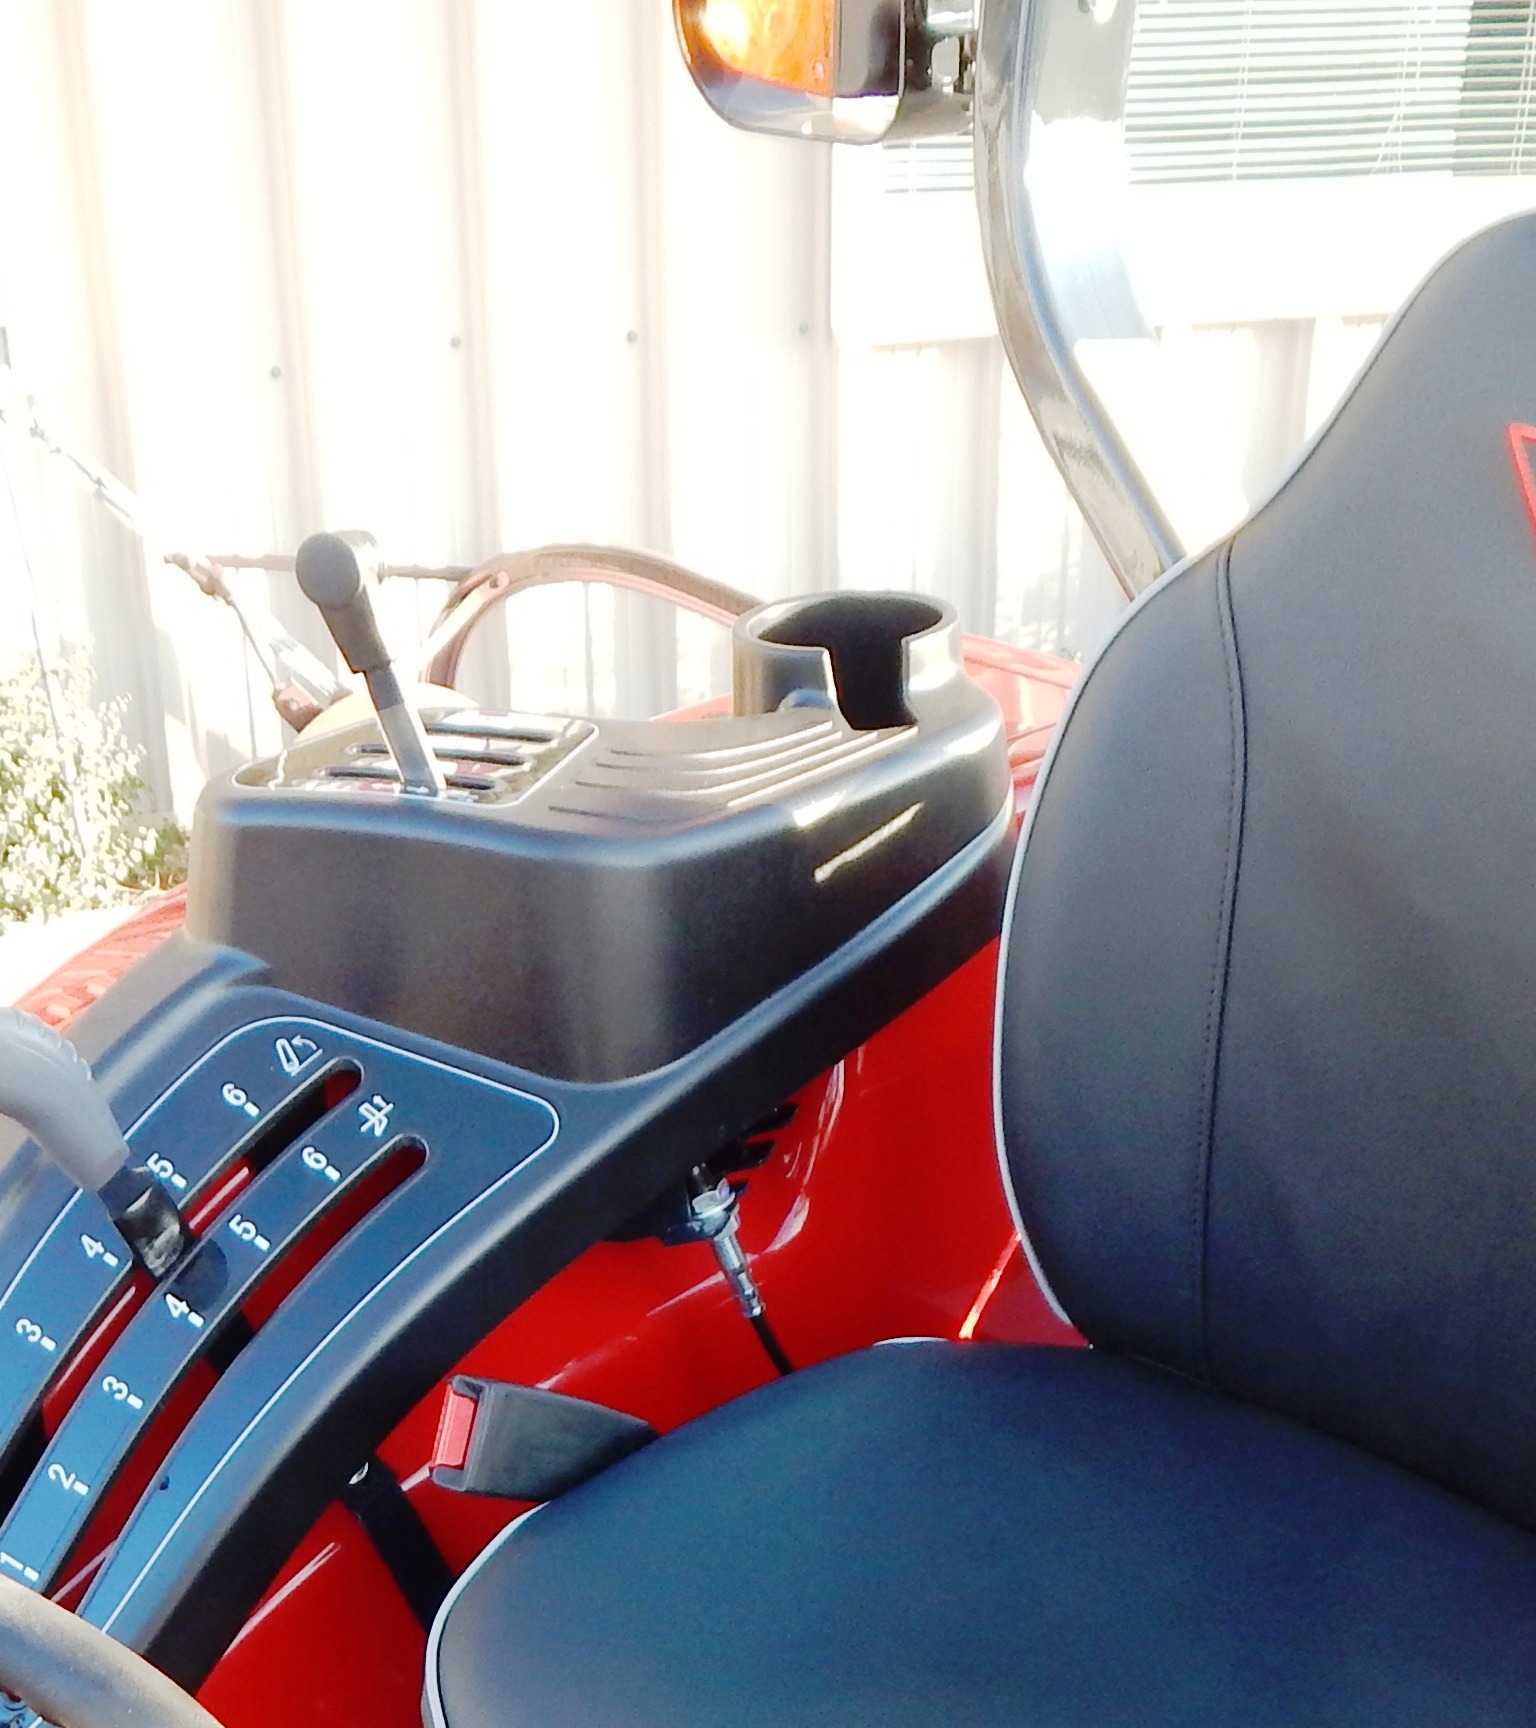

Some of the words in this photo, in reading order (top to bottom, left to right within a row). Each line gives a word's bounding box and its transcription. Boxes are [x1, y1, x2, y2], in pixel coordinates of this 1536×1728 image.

[222, 1083, 247, 1106] 6
[146, 1153, 174, 1178] 5
[302, 1147, 327, 1170] 6
[229, 1214, 256, 1240] 5
[81, 1234, 106, 1258] 4
[165, 1293, 190, 1318] 4
[16, 1318, 42, 1343] 3
[102, 1376, 128, 1400] 3
[48, 1463, 76, 1490] 2
[0, 1551, 24, 1571] 1
